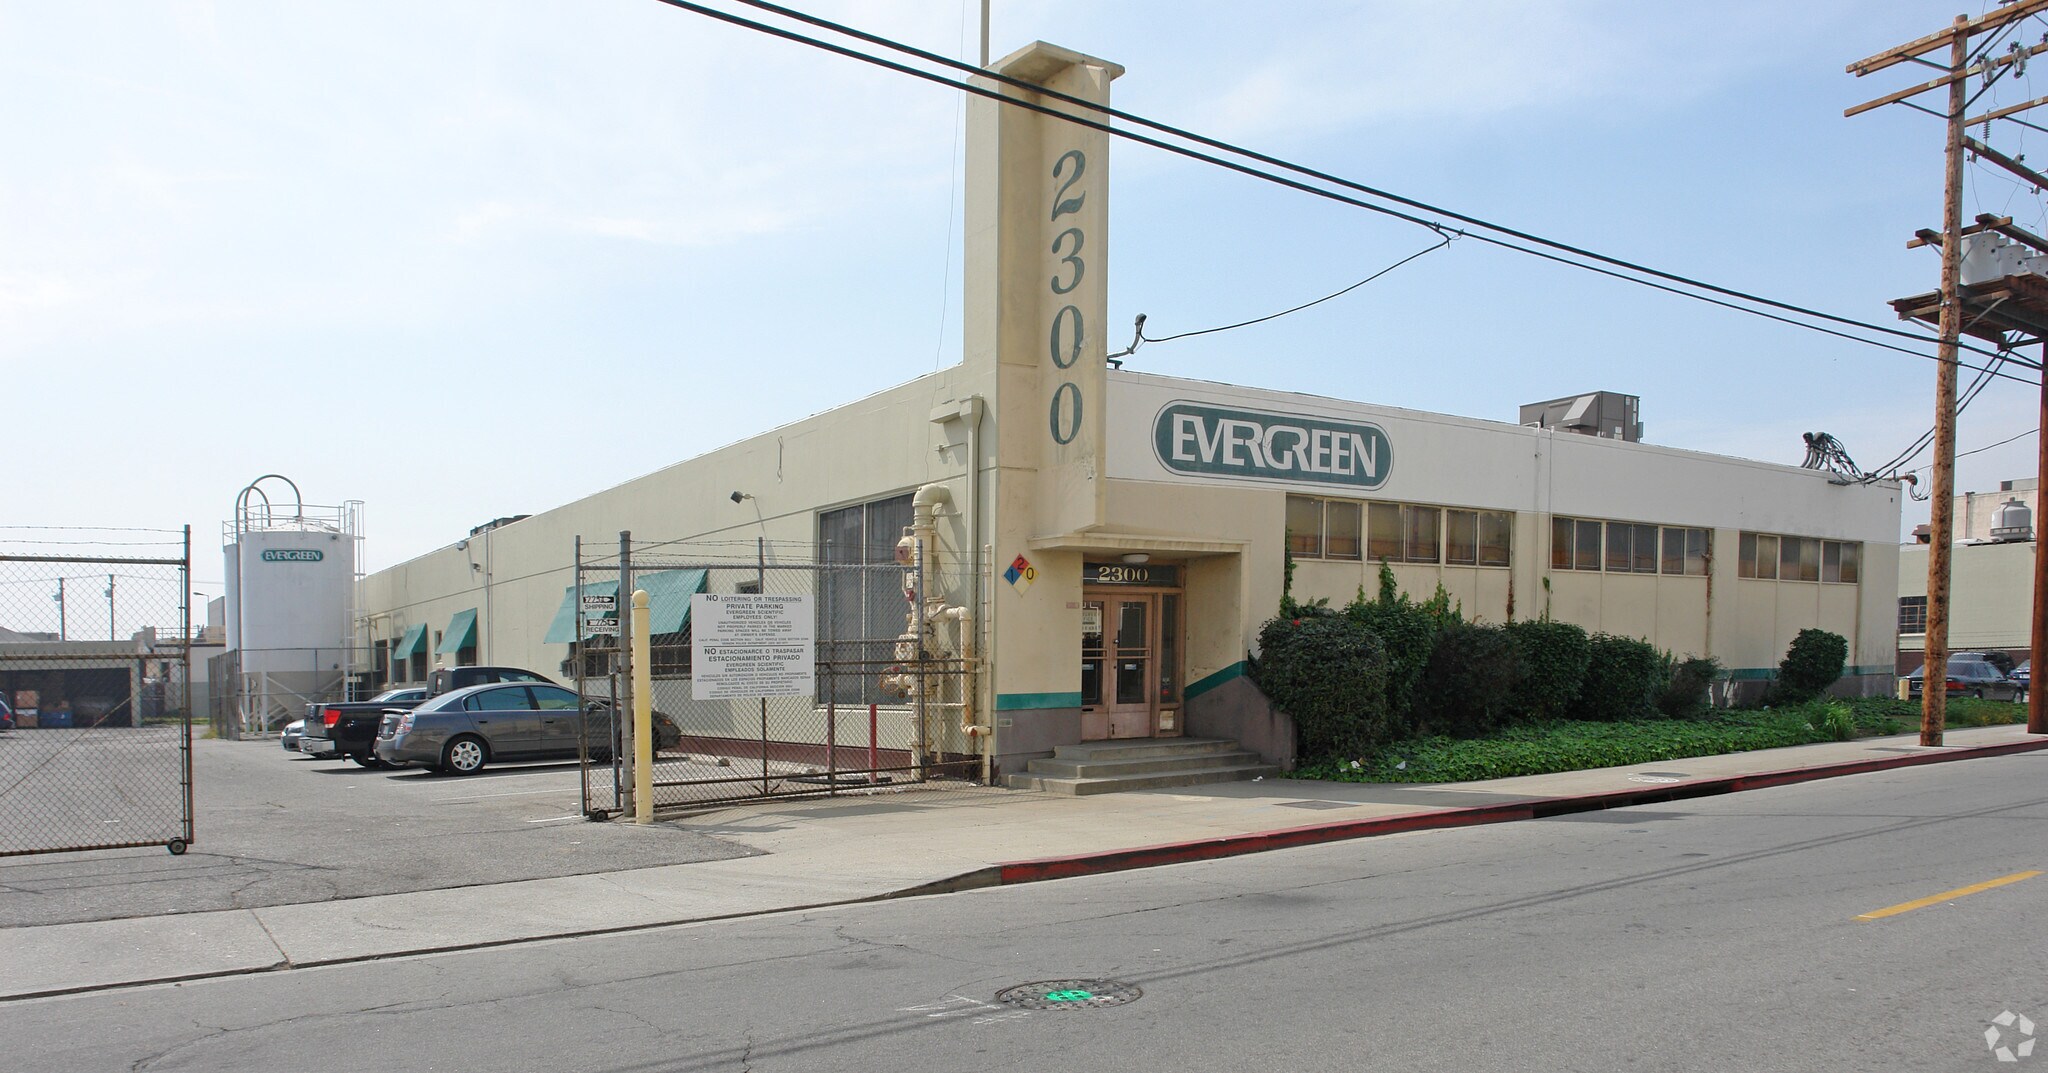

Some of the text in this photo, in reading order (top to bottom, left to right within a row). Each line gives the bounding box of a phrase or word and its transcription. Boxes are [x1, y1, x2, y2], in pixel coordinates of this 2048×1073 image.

[1050, 150, 1087, 445] 2300
[1172, 413, 1377, 478] EVERGREEN
[265, 551, 321, 561] EVERGREEN
[1017, 556, 1025, 571] 2
[1026, 567, 1034, 580] 0
[1098, 566, 1149, 582] 2300
